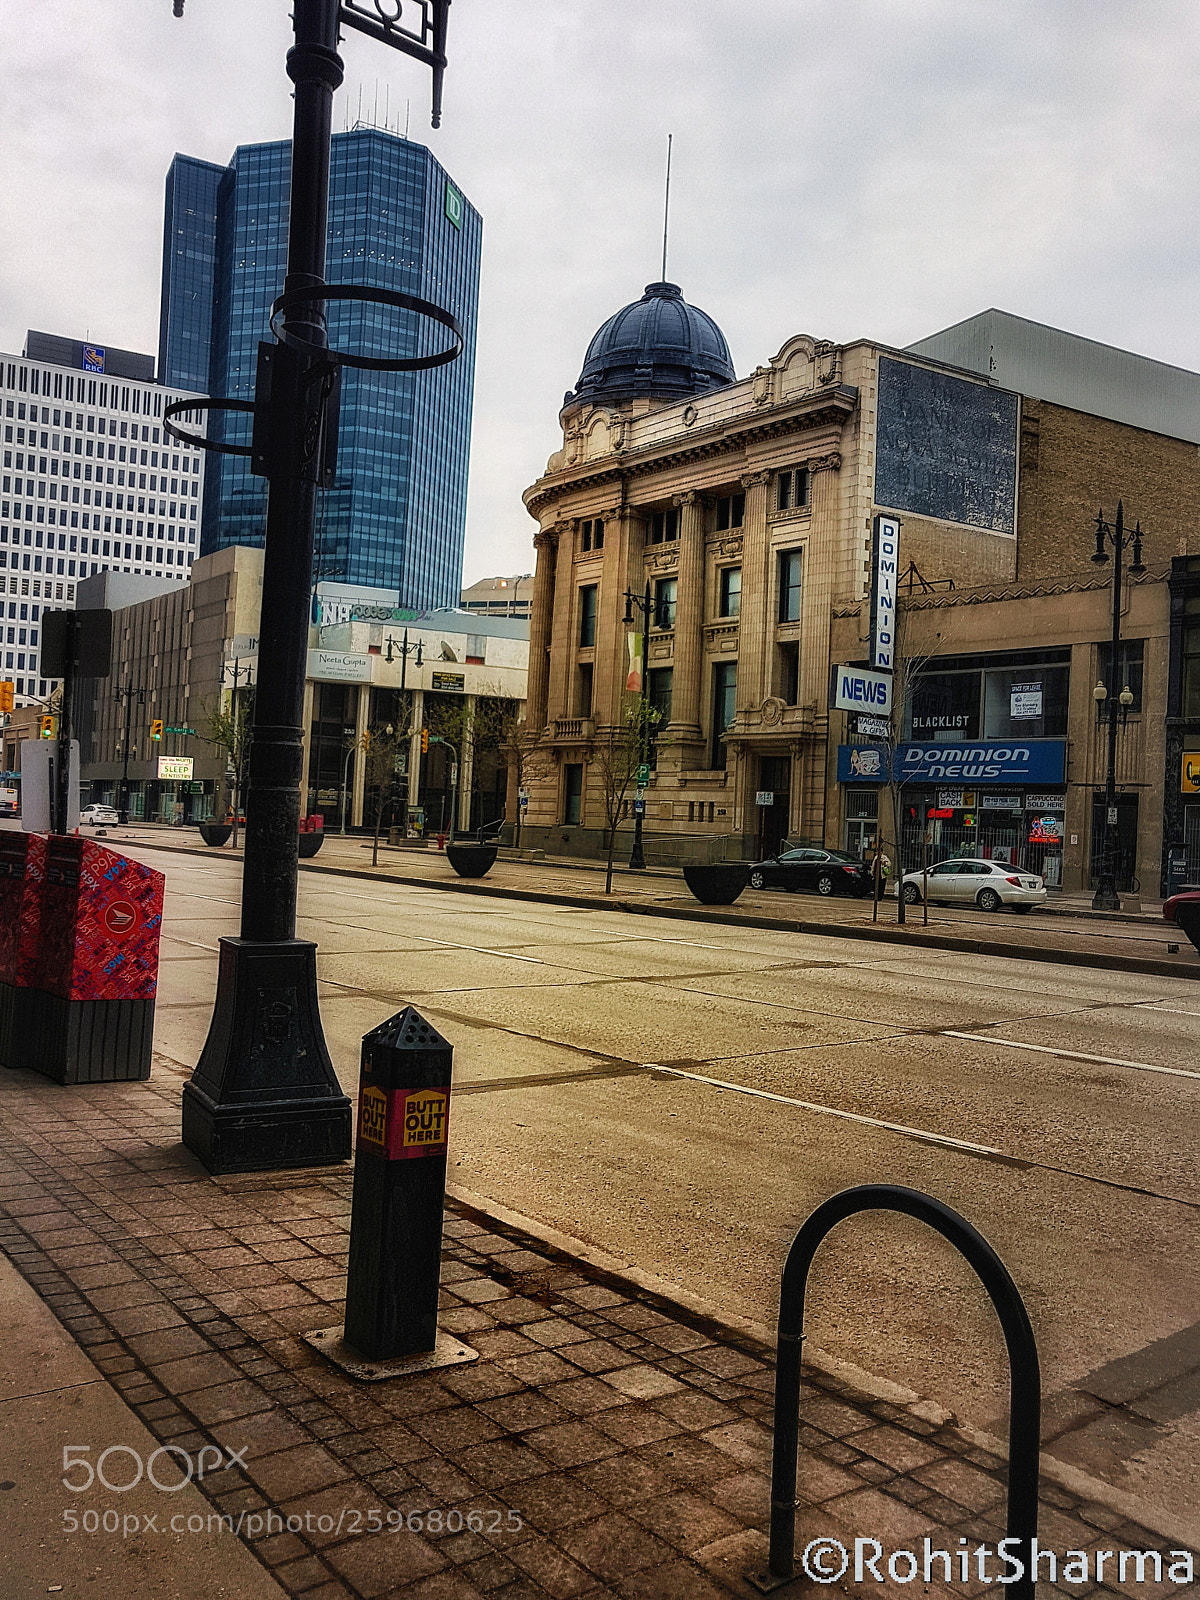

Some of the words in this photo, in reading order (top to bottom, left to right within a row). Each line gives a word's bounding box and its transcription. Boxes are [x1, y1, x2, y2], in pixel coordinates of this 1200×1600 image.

[85, 364, 103, 373] RBC
[878, 524, 895, 666] DOMINION
[319, 653, 342, 664] Neeta
[342, 656, 366, 668] Gupta
[842, 676, 887, 705] NEWS
[164, 765, 189, 773] SLEEP
[639, 765, 648, 778] P
[940, 791, 961, 799] CASH
[940, 799, 962, 807] BACK
[27, 861, 45, 884] H9X
[91, 851, 118, 877] P9A
[80, 869, 100, 891] H9X
[363, 1093, 386, 1113] BUTT
[406, 1099, 445, 1115] BUTT
[363, 1107, 385, 1130] OUT
[406, 1112, 445, 1131] OUT
[363, 1124, 383, 1142] HERE
[408, 1129, 441, 1143] HERE
